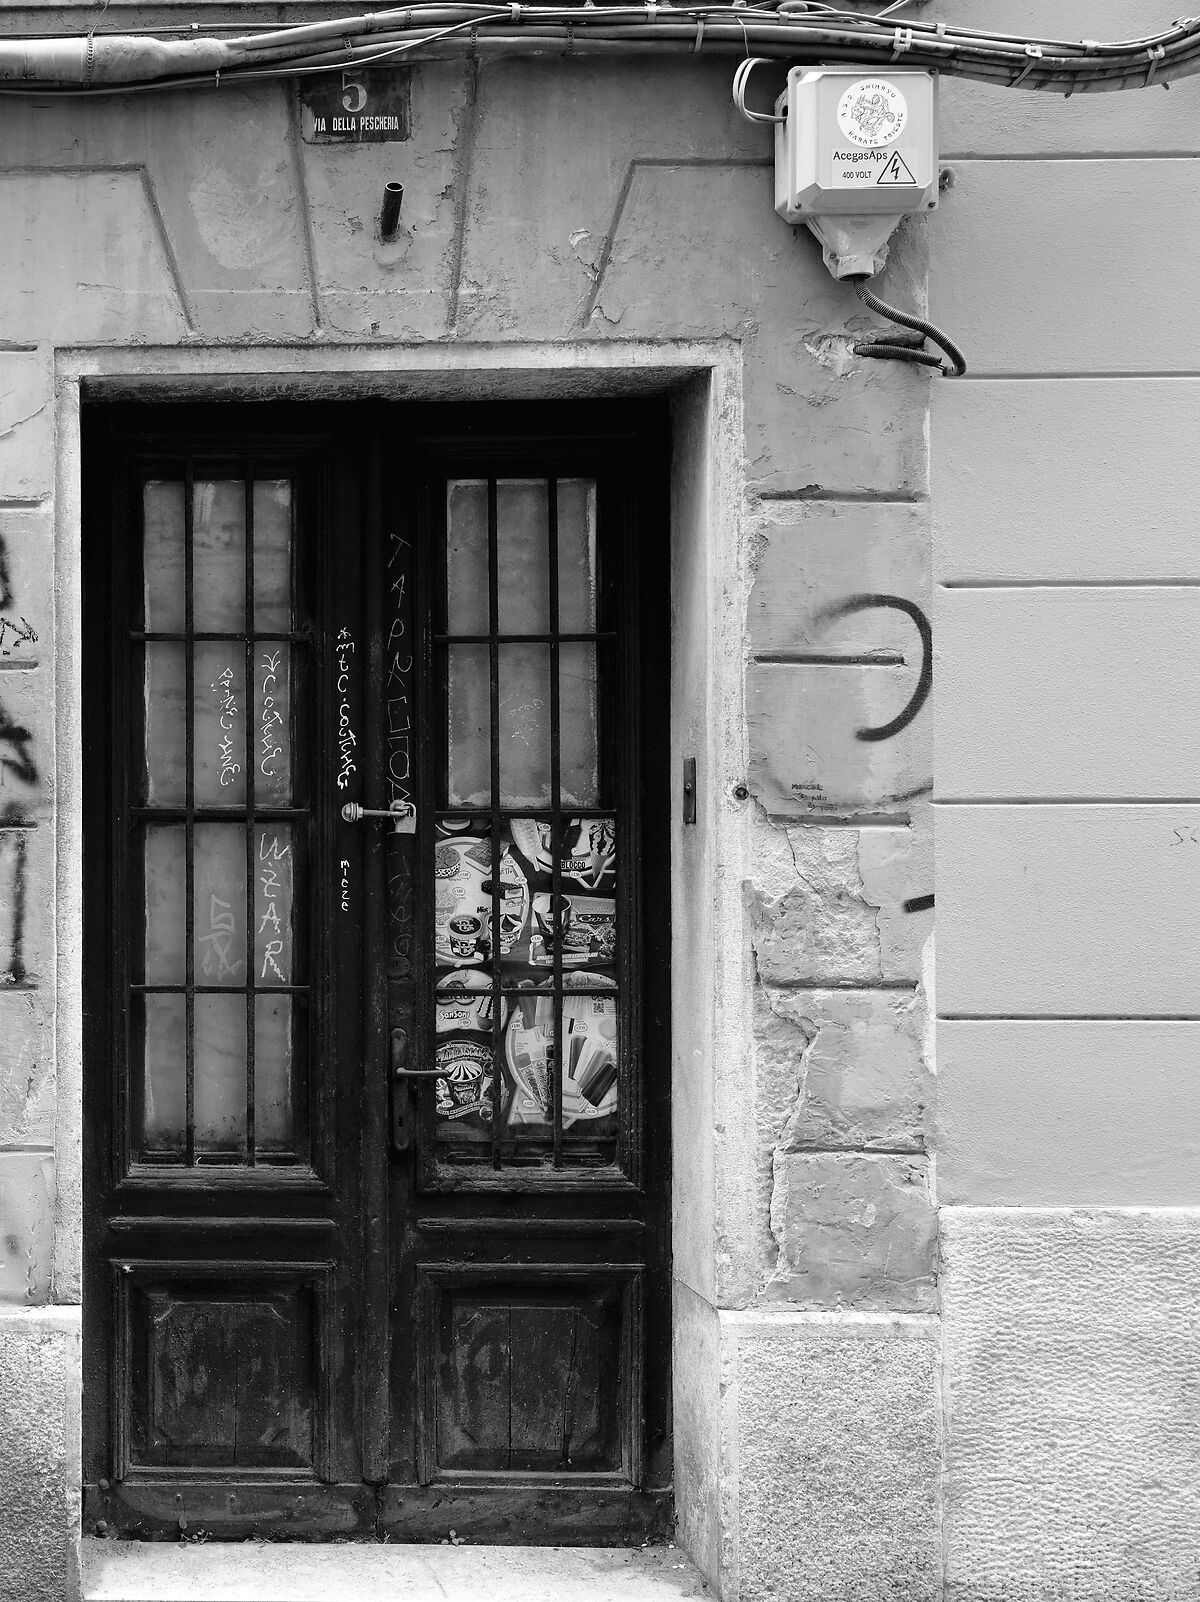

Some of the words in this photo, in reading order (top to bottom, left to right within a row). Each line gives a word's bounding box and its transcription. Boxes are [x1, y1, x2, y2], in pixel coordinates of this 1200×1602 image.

[341, 71, 368, 112] 5
[332, 117, 356, 131] DELLA
[360, 116, 399, 130] PESCHERIA
[832, 150, 888, 161] AcegasAps
[842, 171, 854, 179] 400
[855, 170, 872, 179] VOLT
[561, 861, 586, 869] BLOCCO
